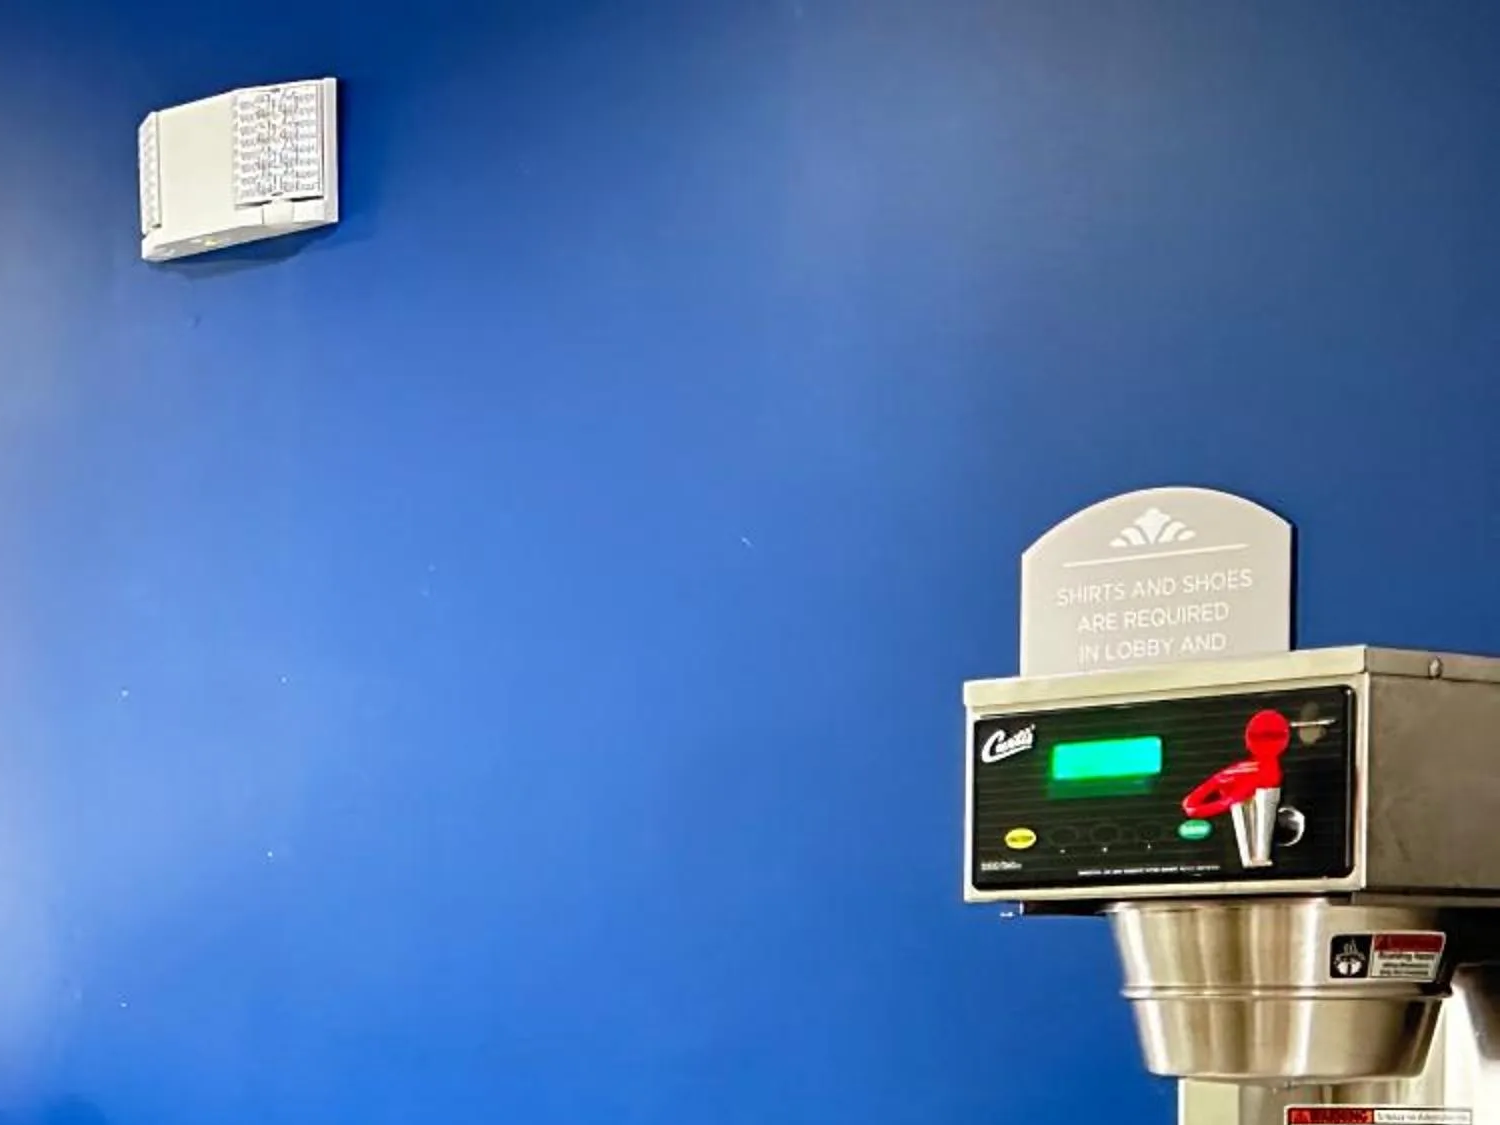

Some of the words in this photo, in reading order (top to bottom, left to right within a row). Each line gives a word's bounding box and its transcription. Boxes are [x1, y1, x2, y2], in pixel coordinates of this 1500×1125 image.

[1056, 583, 1125, 606] SHIRTS
[1132, 578, 1176, 598] AND
[1182, 568, 1253, 593] SHOES
[1076, 612, 1118, 633] ARE
[1124, 601, 1230, 629] REQUIRED
[1078, 644, 1100, 664] IN
[1105, 638, 1175, 661] LOBBY
[1181, 632, 1227, 653] AND
